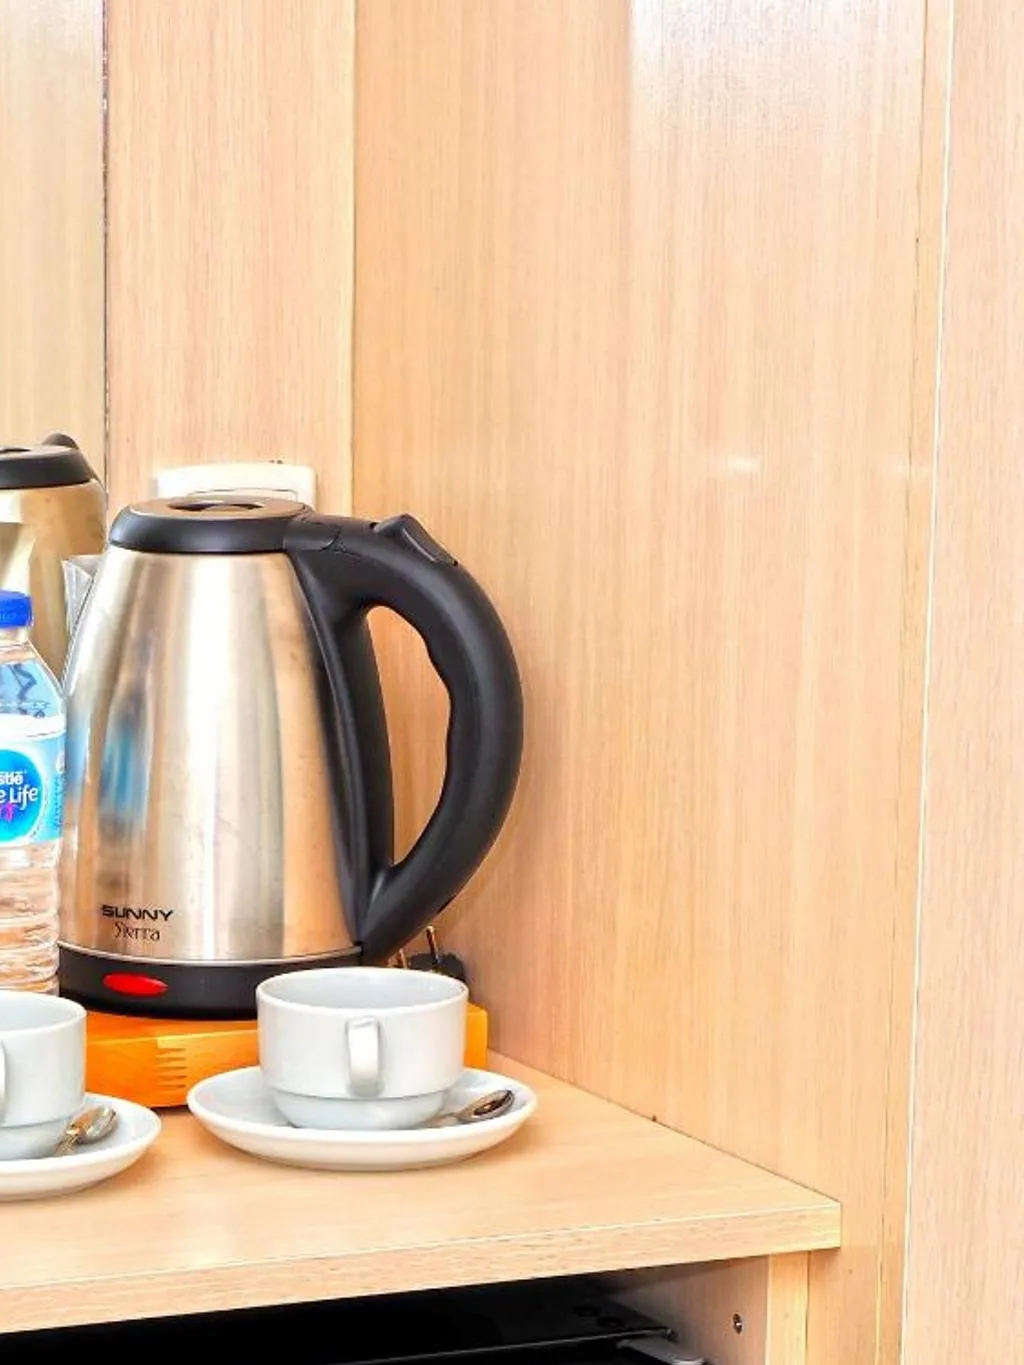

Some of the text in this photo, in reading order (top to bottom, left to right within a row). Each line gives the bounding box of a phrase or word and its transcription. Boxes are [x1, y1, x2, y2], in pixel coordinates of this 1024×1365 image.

[10, 786, 39, 811] Life
[102, 904, 174, 922] SUNNY
[113, 921, 161, 942] Sierra
